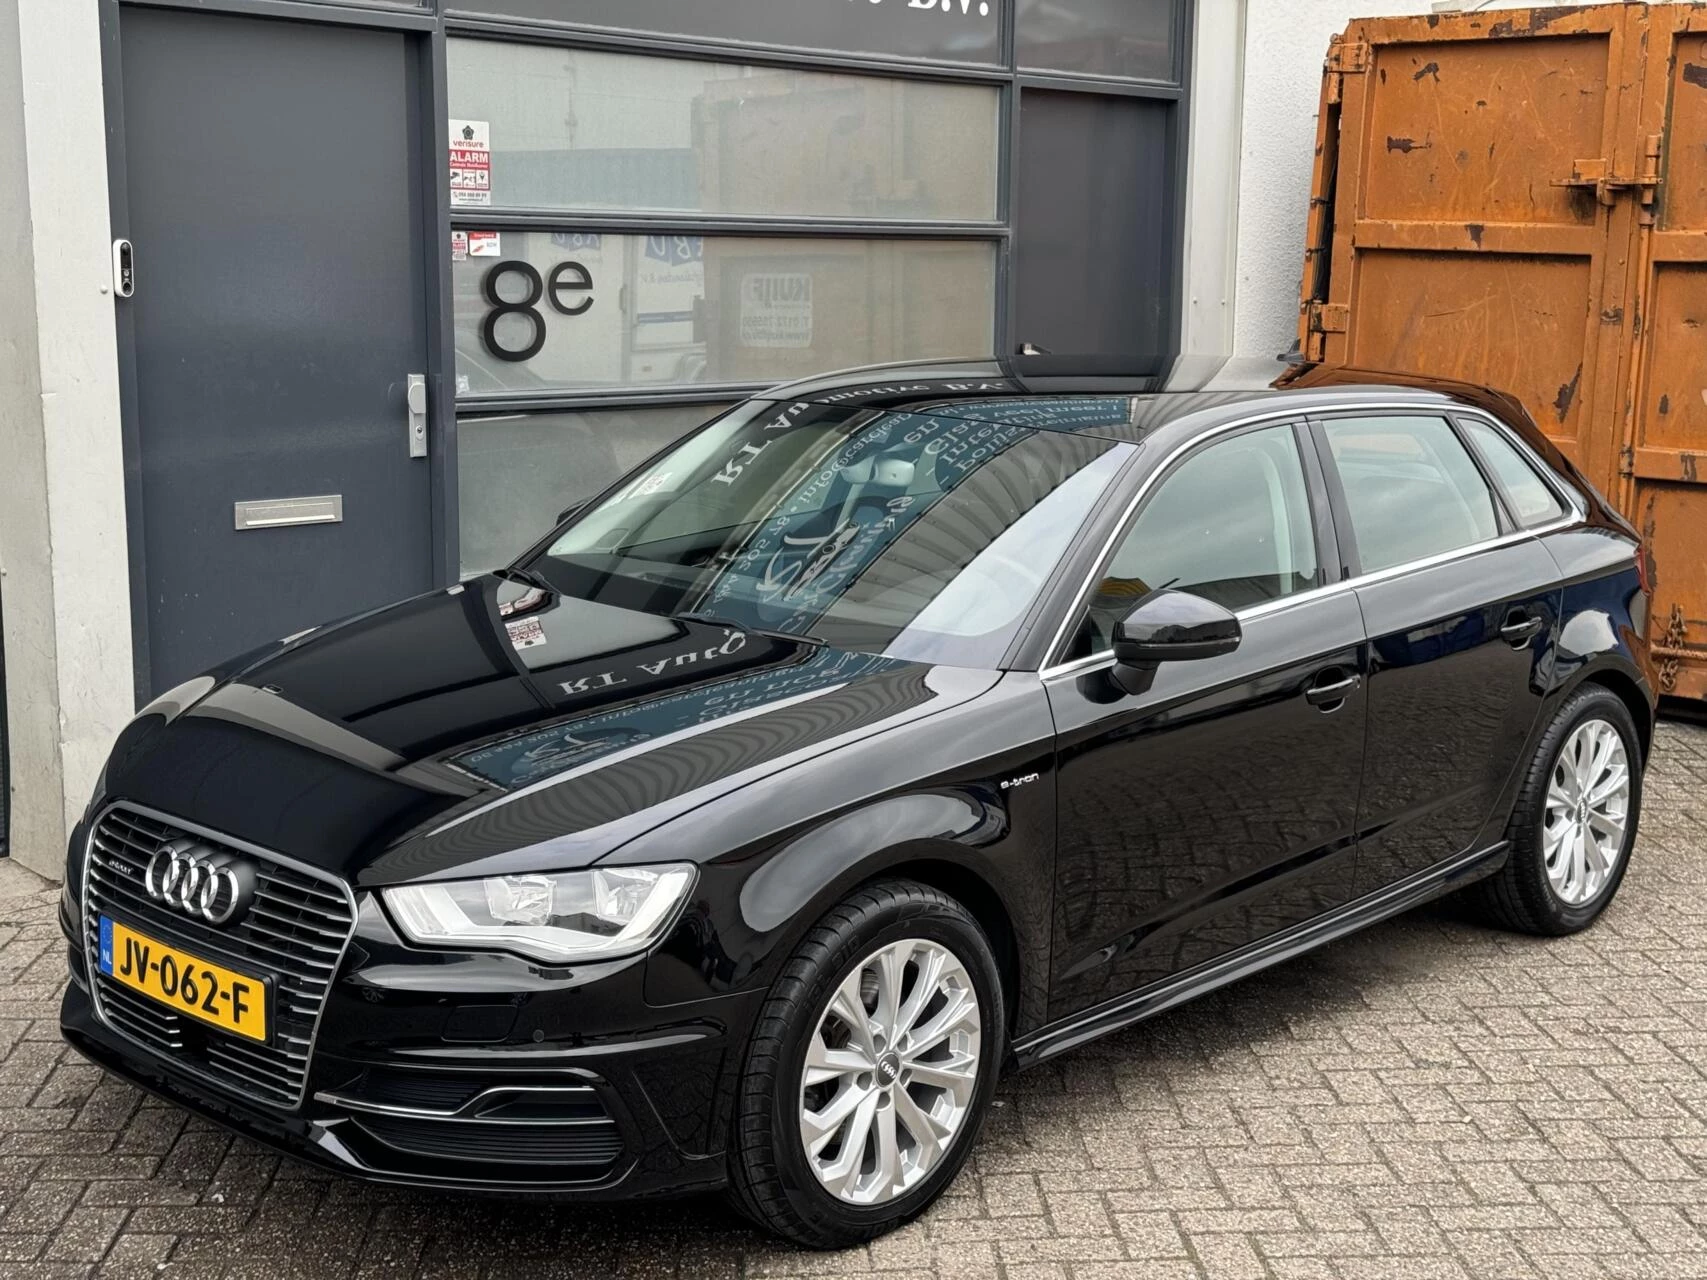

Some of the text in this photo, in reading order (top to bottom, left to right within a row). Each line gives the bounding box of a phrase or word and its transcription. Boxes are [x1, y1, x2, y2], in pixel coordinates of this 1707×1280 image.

[450, 151, 488, 163] ALARM
[484, 260, 594, 363] 8e
[1000, 772, 1039, 789] e-tron
[102, 936, 250, 1025] NL JV-062-F
